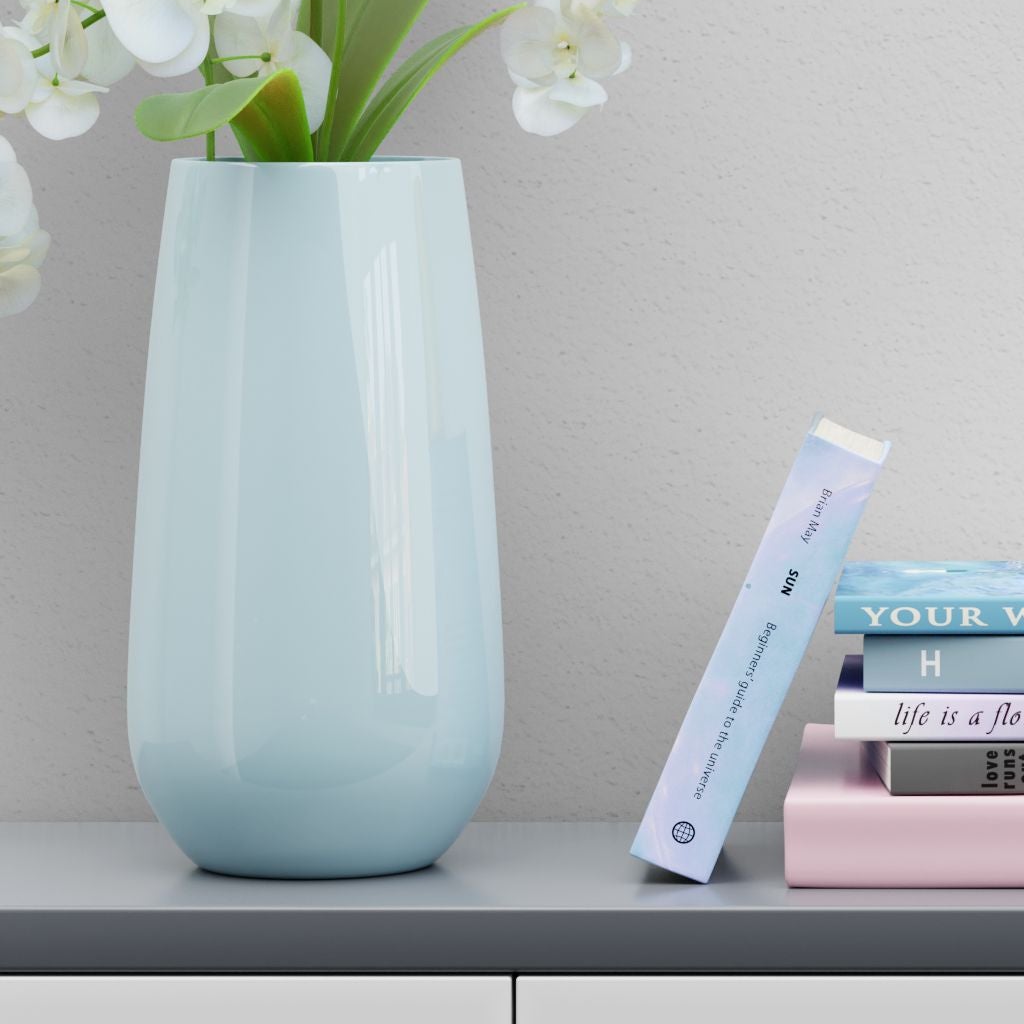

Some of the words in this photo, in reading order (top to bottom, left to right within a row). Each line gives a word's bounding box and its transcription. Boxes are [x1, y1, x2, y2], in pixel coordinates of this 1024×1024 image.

[813, 488, 832, 517] Brian
[800, 520, 820, 544] May
[781, 568, 799, 596] SUN
[860, 606, 989, 627] YOUR
[730, 680, 749, 714] guide
[723, 716, 735, 729] to
[893, 702, 930, 735] life
[941, 705, 959, 726] is
[968, 711, 984, 726] a
[714, 730, 729, 750] the
[693, 752, 719, 800] universe
[981, 750, 999, 788] love
[1003, 749, 1016, 789] runs
